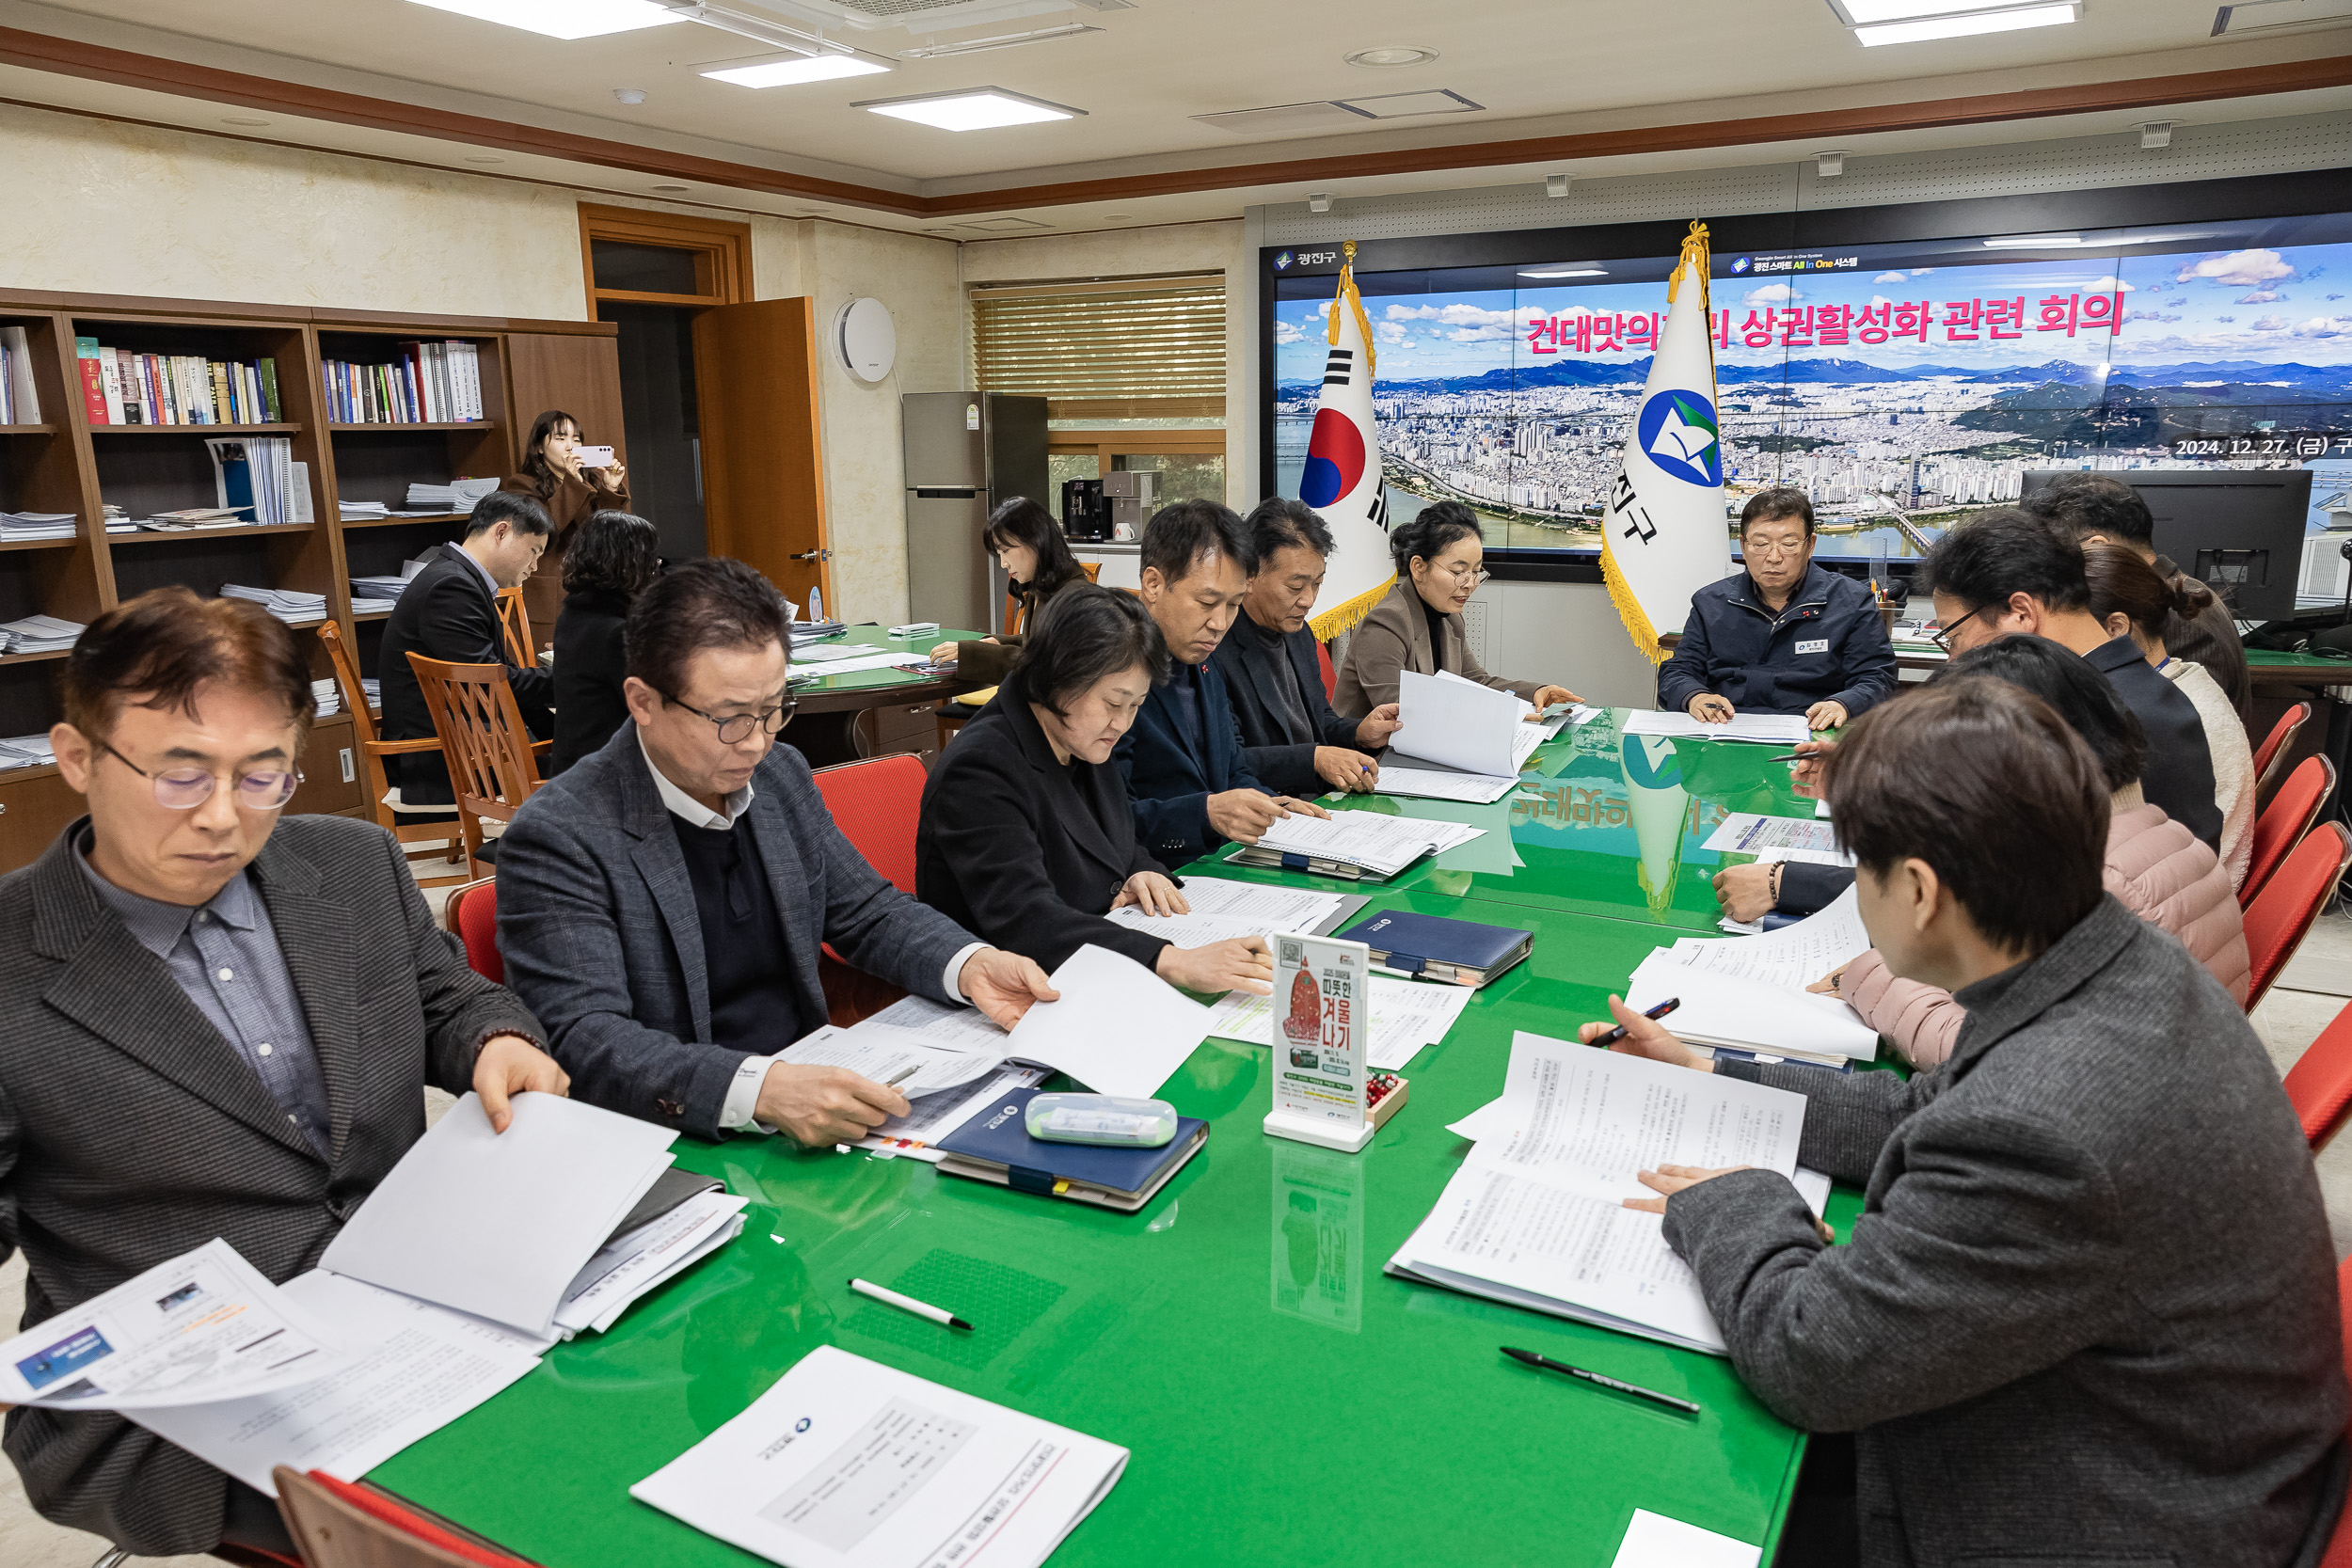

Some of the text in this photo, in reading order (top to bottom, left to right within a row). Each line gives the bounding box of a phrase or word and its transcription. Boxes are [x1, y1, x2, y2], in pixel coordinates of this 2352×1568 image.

[1297, 252, 1337, 265] 광진구
[1793, 261, 1804, 269] All
[1815, 260, 1834, 268] One
[1740, 300, 1933, 348] 상권활성화
[1943, 296, 2025, 341] 관련
[2036, 291, 2124, 337] 회의
[2175, 439, 2224, 455] 2024.
[2229, 439, 2256, 454] 12.
[2262, 439, 2290, 454] 27.
[2296, 436, 2328, 455] (금)
[1611, 456, 1658, 546] 진구
[1323, 978, 1351, 999] 따뜻한
[1323, 997, 1351, 1025] 겨울
[1323, 1022, 1351, 1052] 나기
